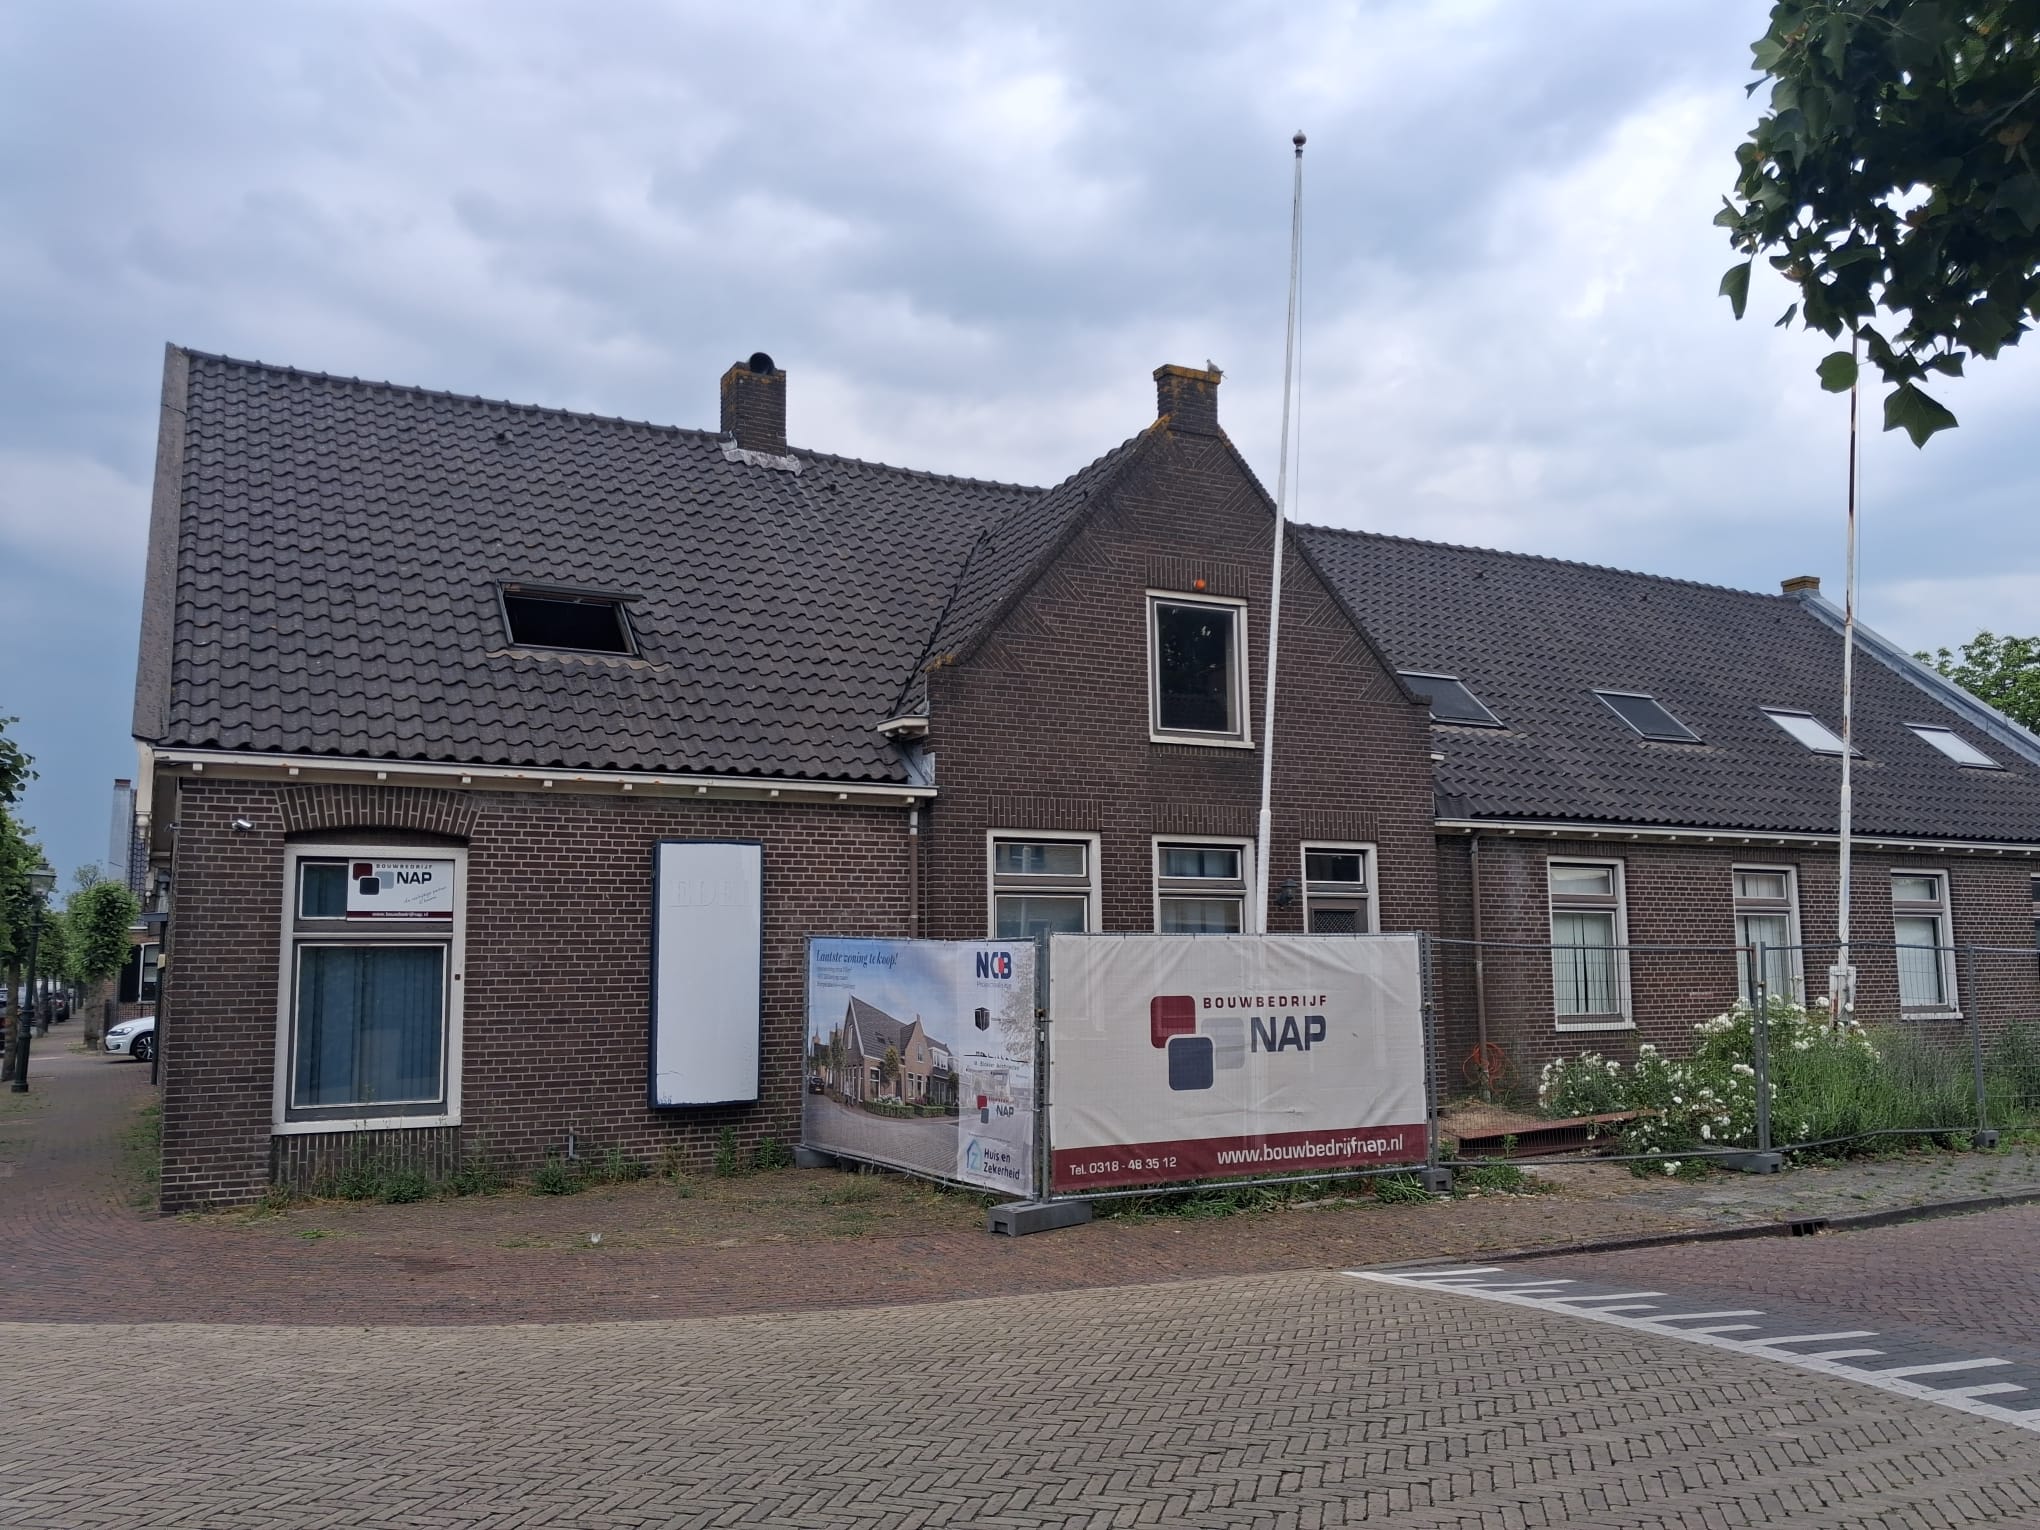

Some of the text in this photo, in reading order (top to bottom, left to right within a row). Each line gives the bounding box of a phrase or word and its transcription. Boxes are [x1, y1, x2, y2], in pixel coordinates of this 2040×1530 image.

[396, 871, 432, 885] NAP
[816, 949, 841, 963] Laatste
[976, 951, 1012, 980] NCB
[1202, 995, 1328, 1009] BOUWBEDRIJF
[1250, 1015, 1327, 1053] NAP
[996, 1104, 1015, 1118] NAP
[984, 1147, 1011, 1163] Huis en
[1216, 1133, 1404, 1166] www.bouwbedrijfnap.nl
[983, 1161, 1020, 1180] Zekerheid
[1069, 1164, 1087, 1176] Tel.
[1089, 1160, 1120, 1174] 0318
[1128, 1159, 1143, 1170] 48
[1145, 1157, 1160, 1169] 35
[1162, 1156, 1177, 1168] 12
